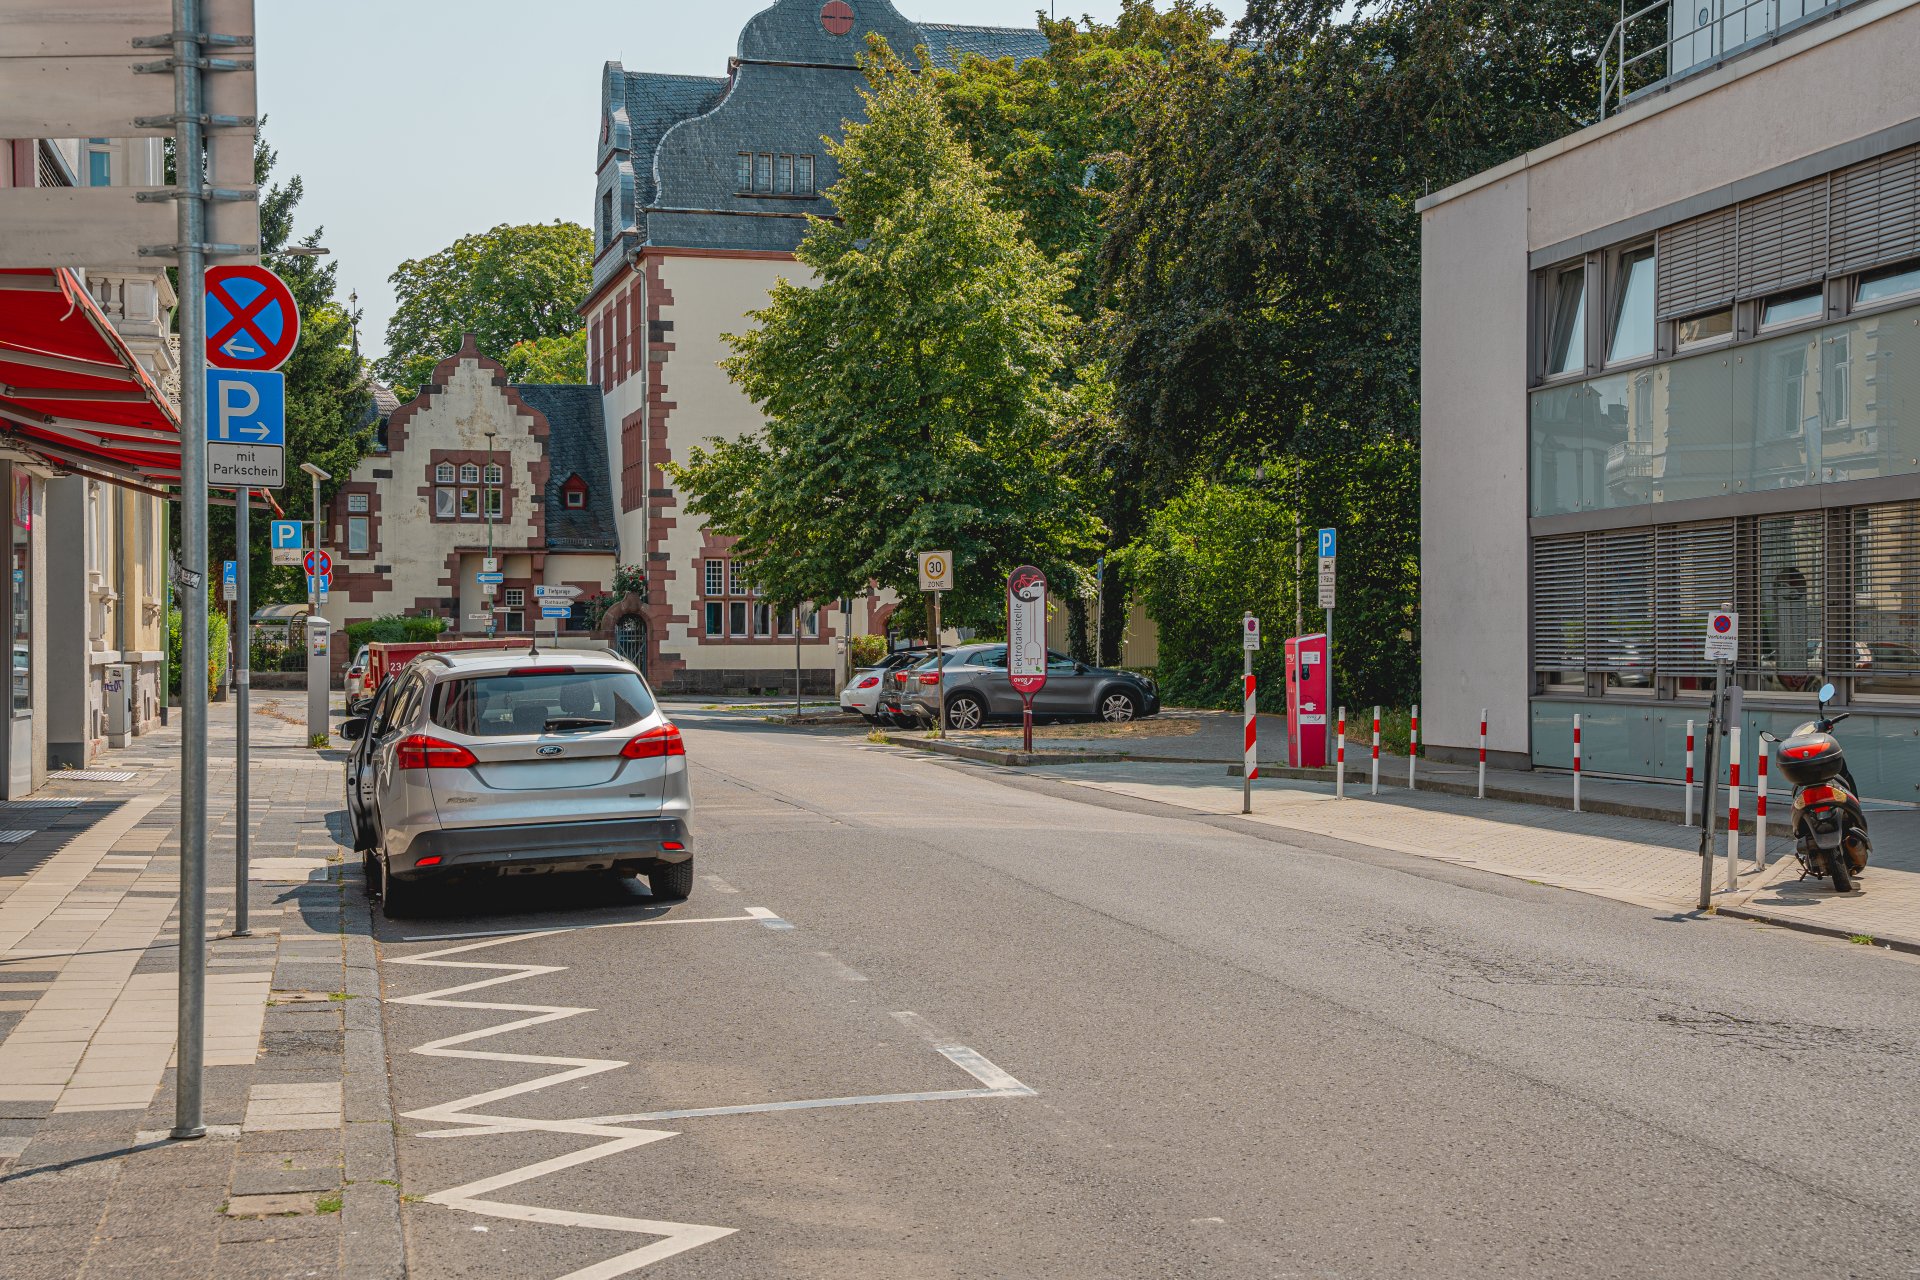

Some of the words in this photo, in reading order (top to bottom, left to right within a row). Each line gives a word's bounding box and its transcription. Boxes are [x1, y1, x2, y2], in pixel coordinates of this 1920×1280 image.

[218, 379, 260, 439] P
[236, 452, 256, 462] mit
[213, 463, 278, 477] Parkschein
[278, 524, 295, 548] P
[1322, 532, 1332, 557] P
[225, 562, 233, 573] P
[928, 561, 942, 573] 30
[927, 580, 944, 588] ZONE
[1013, 603, 1023, 674] Elektrotankstelle
[542, 745, 559, 754] Ford
